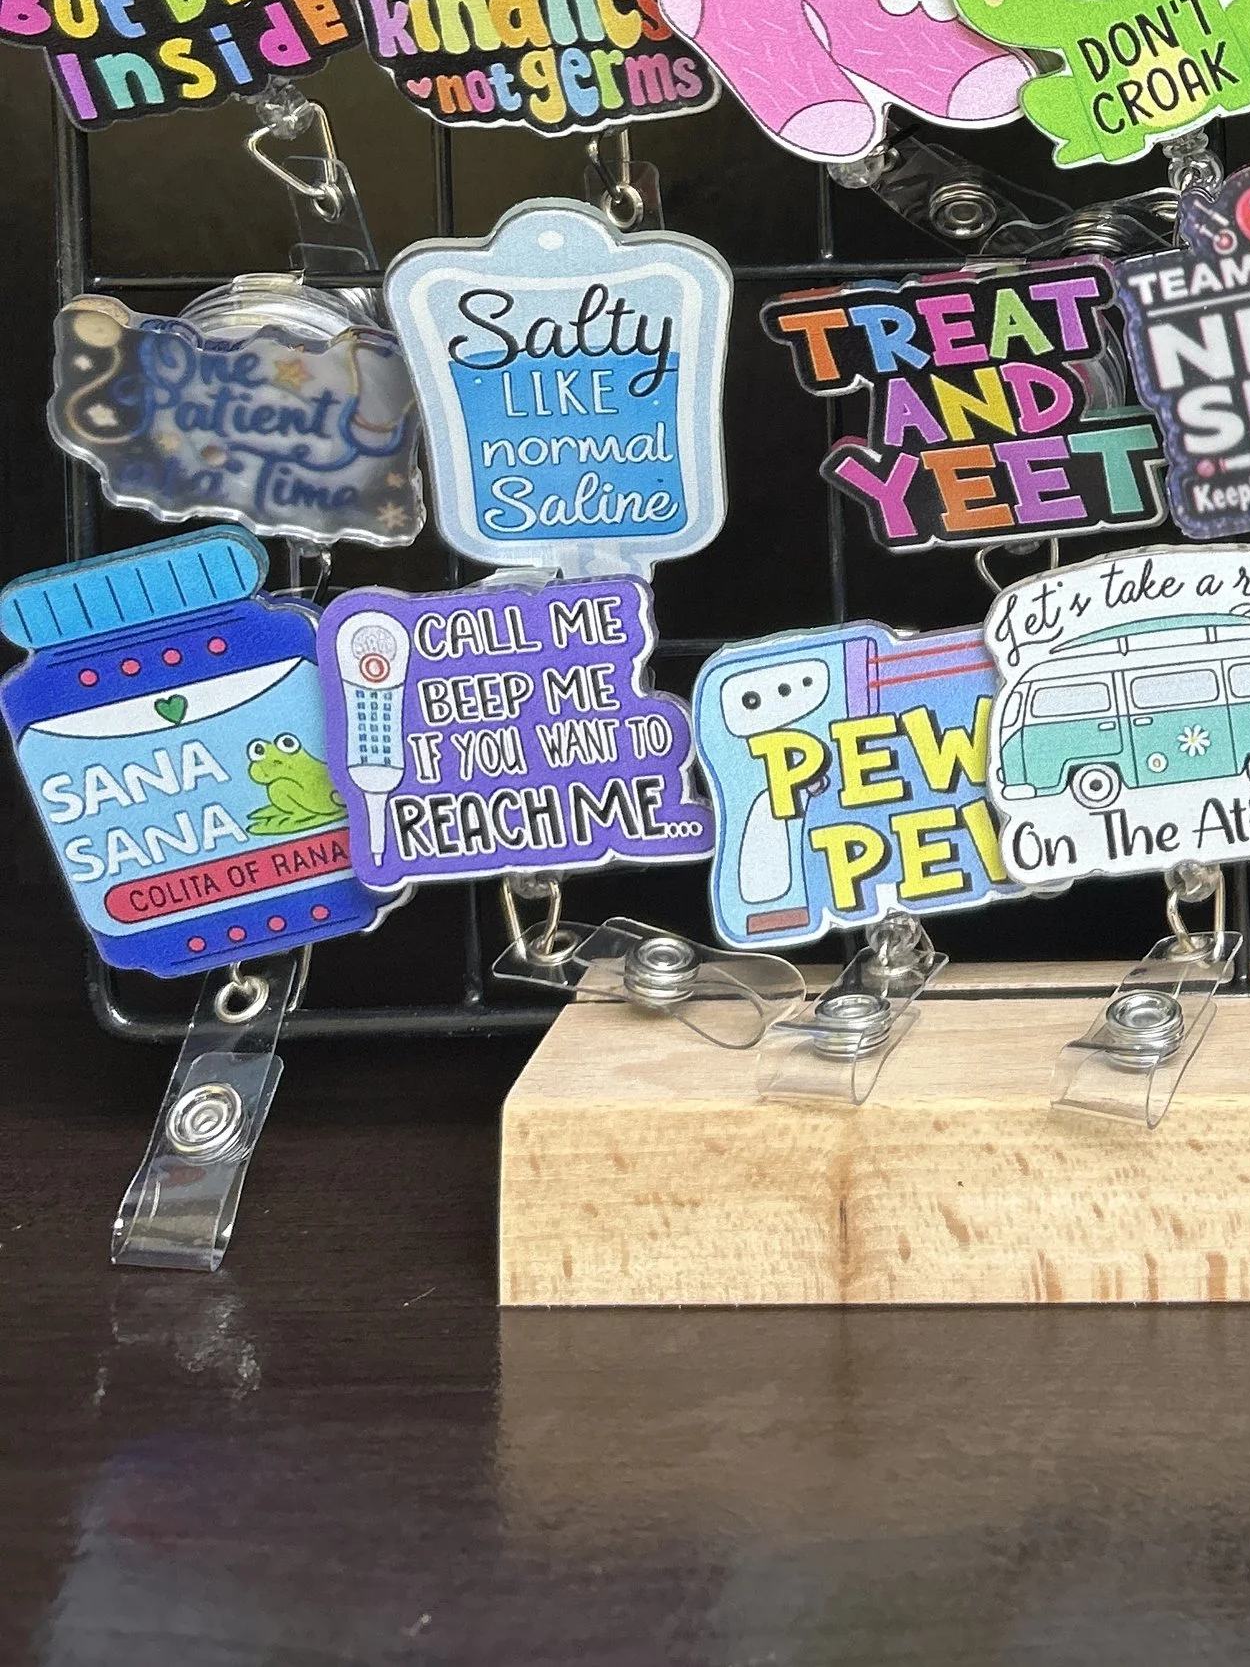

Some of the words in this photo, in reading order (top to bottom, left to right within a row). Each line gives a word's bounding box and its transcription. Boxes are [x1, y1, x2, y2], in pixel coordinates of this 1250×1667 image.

[435, 63, 521, 114] not
[520, 46, 702, 124] germs
[1091, 55, 1240, 136] CROAK
[138, 331, 268, 386] One
[448, 284, 674, 397] Salty
[779, 277, 1100, 381] TREAT
[138, 379, 342, 440] Patient
[503, 370, 618, 417] LIKE
[884, 362, 1073, 447] AND
[250, 446, 360, 516] Time
[482, 422, 674, 468] normal
[836, 424, 1159, 538] YEET
[484, 471, 679, 532] Saline
[413, 609, 542, 663] CALL
[548, 597, 627, 647] ME
[994, 582, 1090, 666] Let's
[1102, 558, 1183, 612] take
[1196, 575, 1224, 597] a
[418, 672, 534, 725] BEEP
[542, 663, 621, 714] ME
[42, 739, 231, 825] SANA
[407, 733, 441, 784] IF
[450, 730, 524, 782] YOU
[534, 719, 618, 770] WANT
[624, 715, 673, 758] TO
[750, 694, 992, 821] PEW
[66, 805, 248, 883] SANA
[392, 784, 573, 860] REACH
[572, 777, 704, 846] ME...
[1012, 820, 1076, 872] On
[1091, 806, 1180, 861] The
[129, 873, 221, 912] COLITA
[227, 861, 259, 888] OF
[272, 840, 348, 877] RANA
